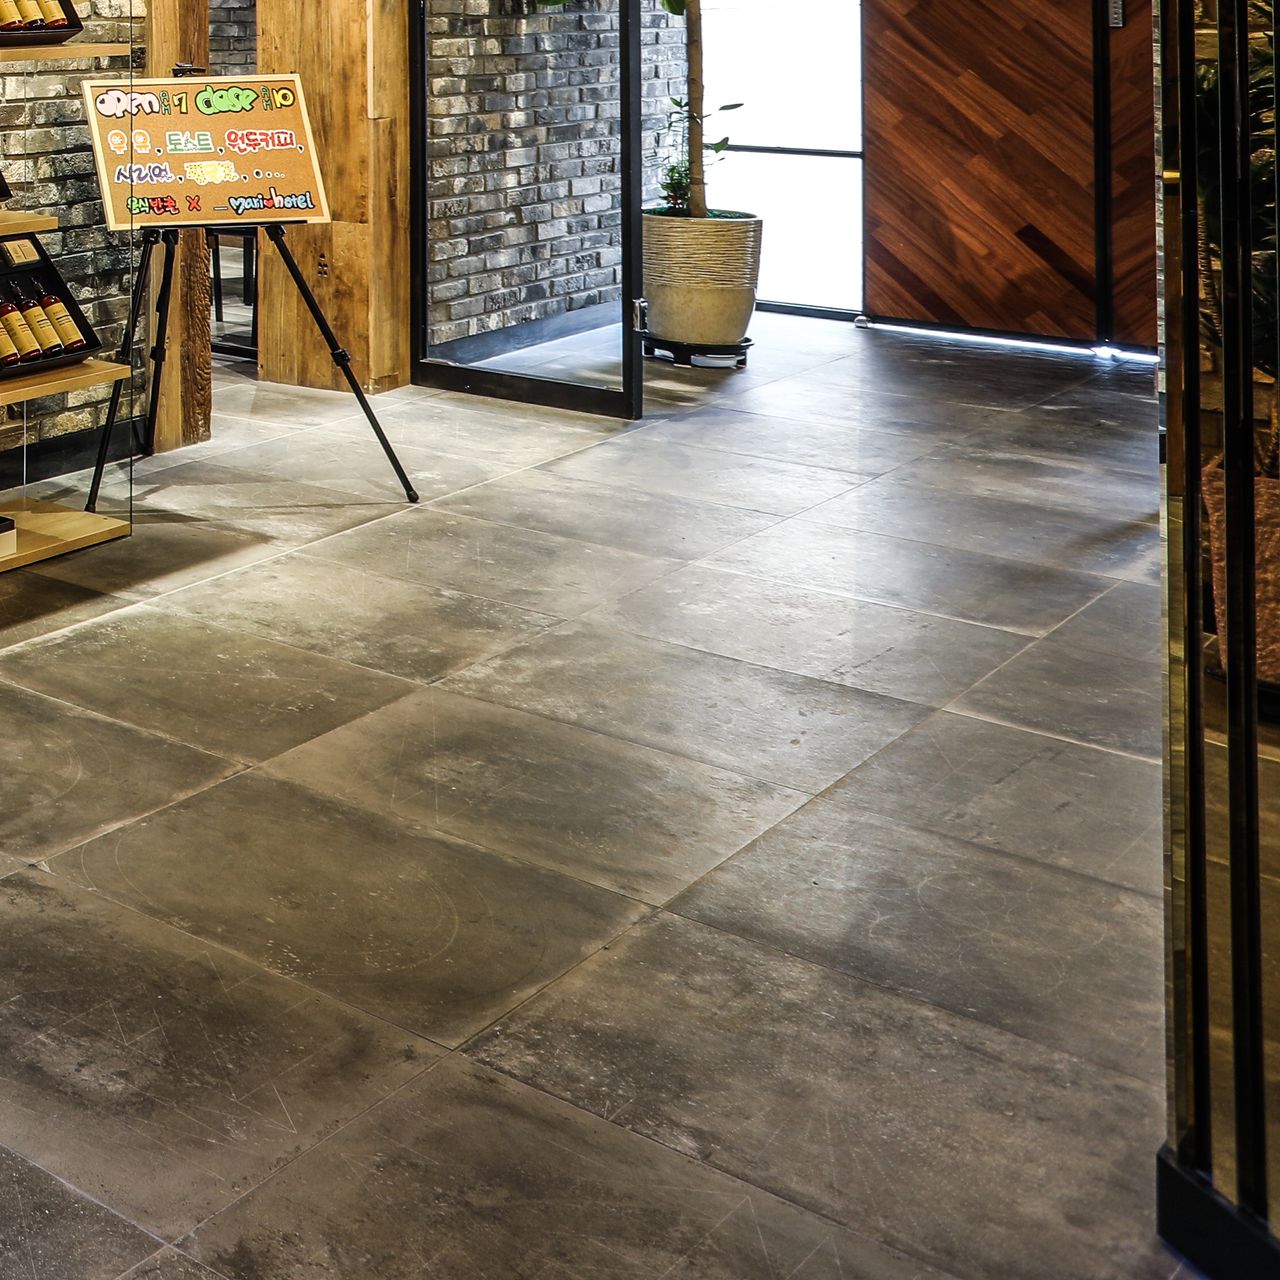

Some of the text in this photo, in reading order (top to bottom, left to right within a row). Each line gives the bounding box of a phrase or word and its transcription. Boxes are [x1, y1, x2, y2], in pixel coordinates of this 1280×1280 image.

[173, 92, 188, 115] 7
[273, 88, 295, 109] 10
[186, 195, 201, 212] X
